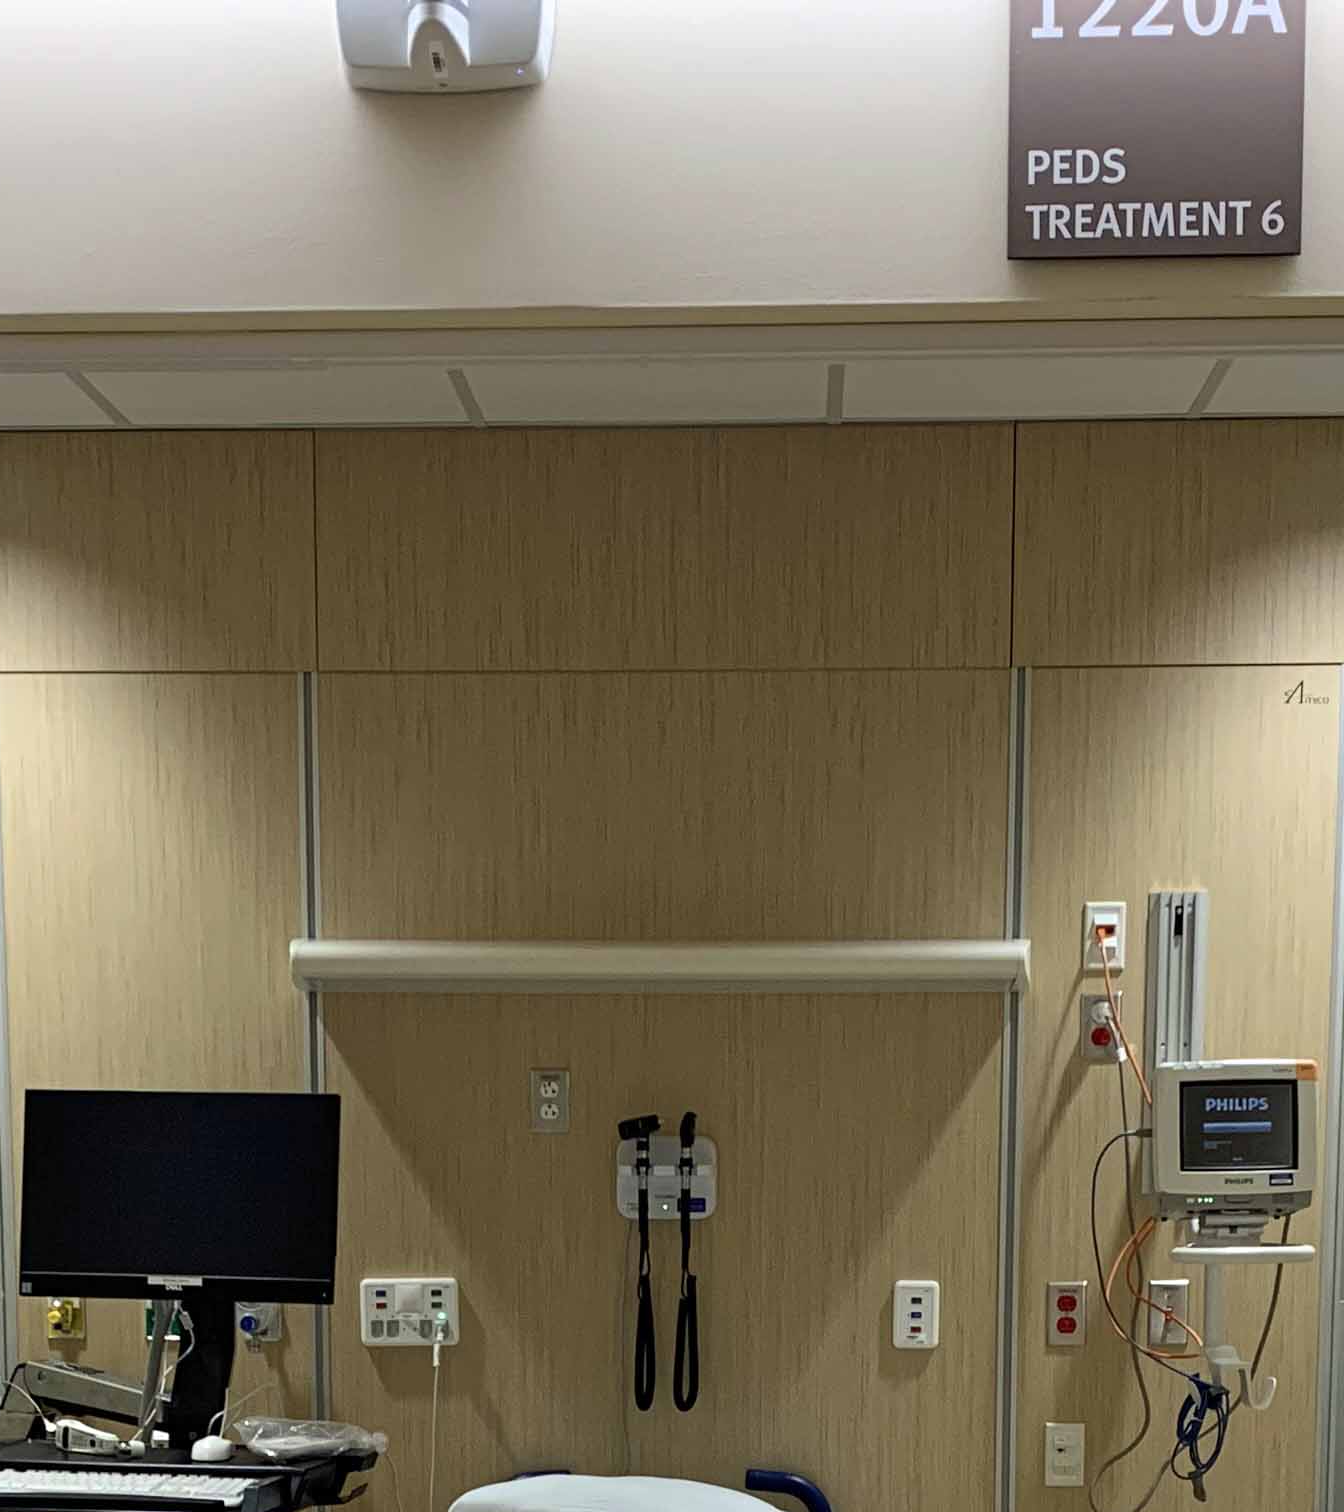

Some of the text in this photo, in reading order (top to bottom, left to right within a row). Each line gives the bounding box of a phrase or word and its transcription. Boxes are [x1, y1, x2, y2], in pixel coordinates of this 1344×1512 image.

[1027, 147, 1127, 185] PEDS
[1025, 199, 1286, 240] TREATMENT 6
[1205, 1097, 1270, 1112] PHILIPS
